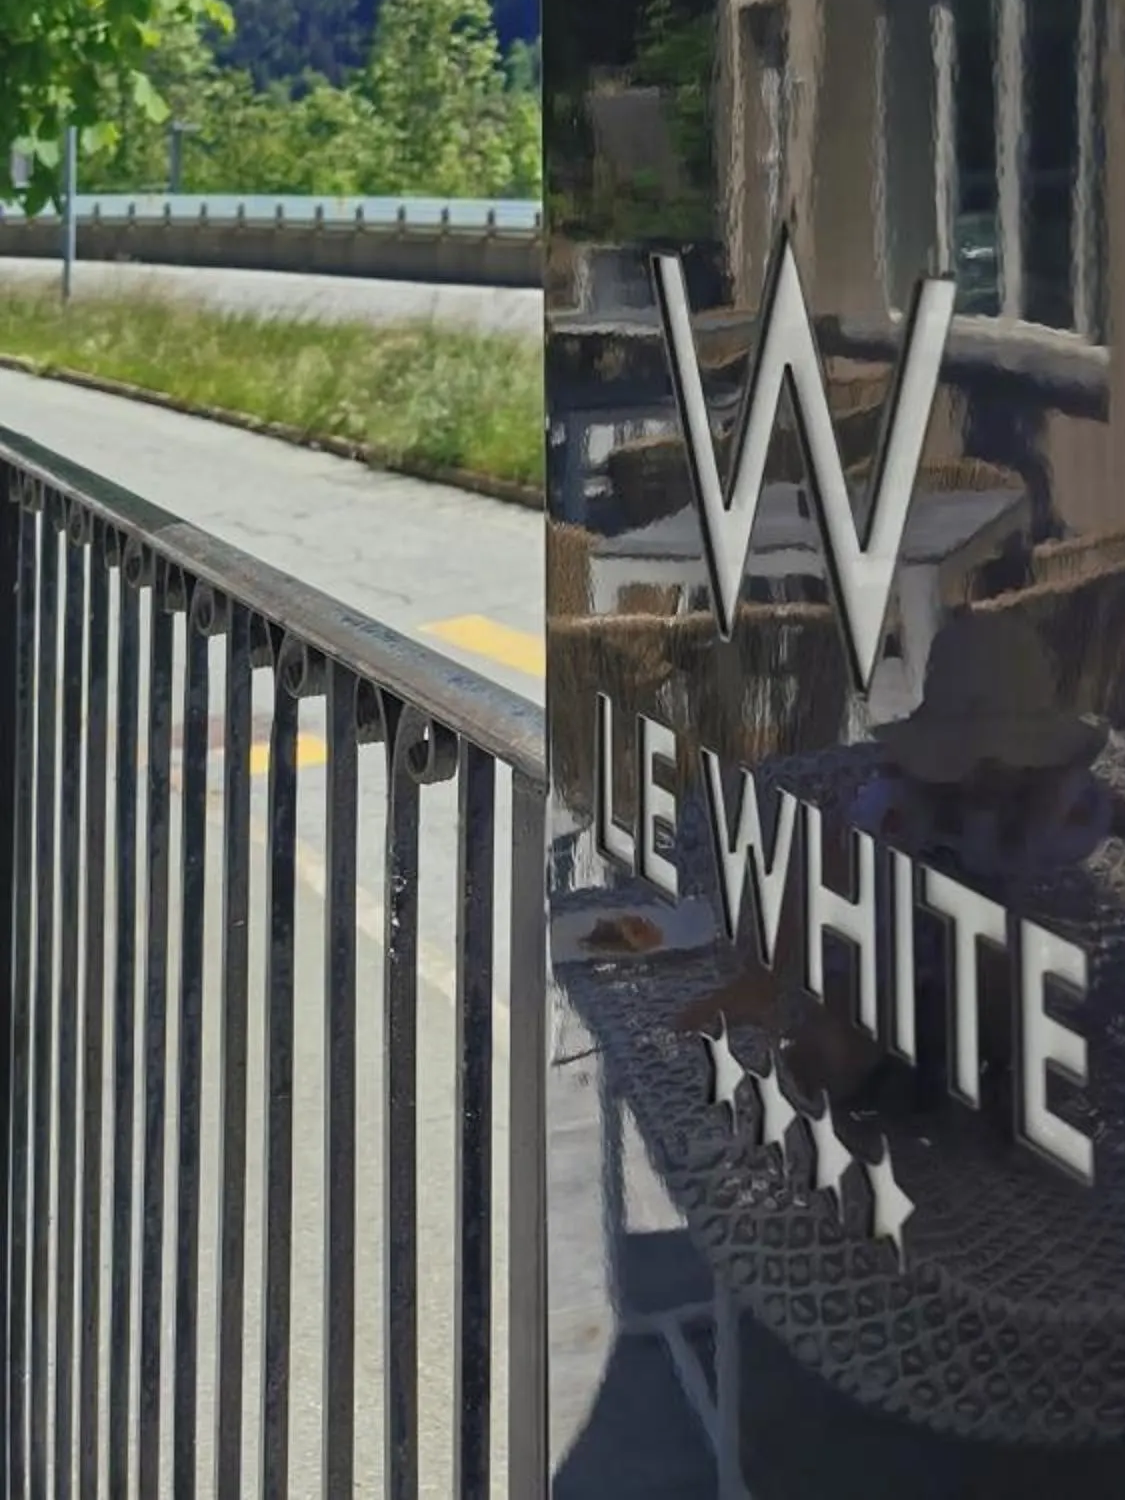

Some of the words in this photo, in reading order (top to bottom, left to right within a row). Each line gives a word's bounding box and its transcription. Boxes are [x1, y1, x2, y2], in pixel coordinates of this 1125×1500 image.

[650, 227, 956, 696] W
[596, 692, 679, 902] LE
[700, 746, 1094, 1185] WHITE
